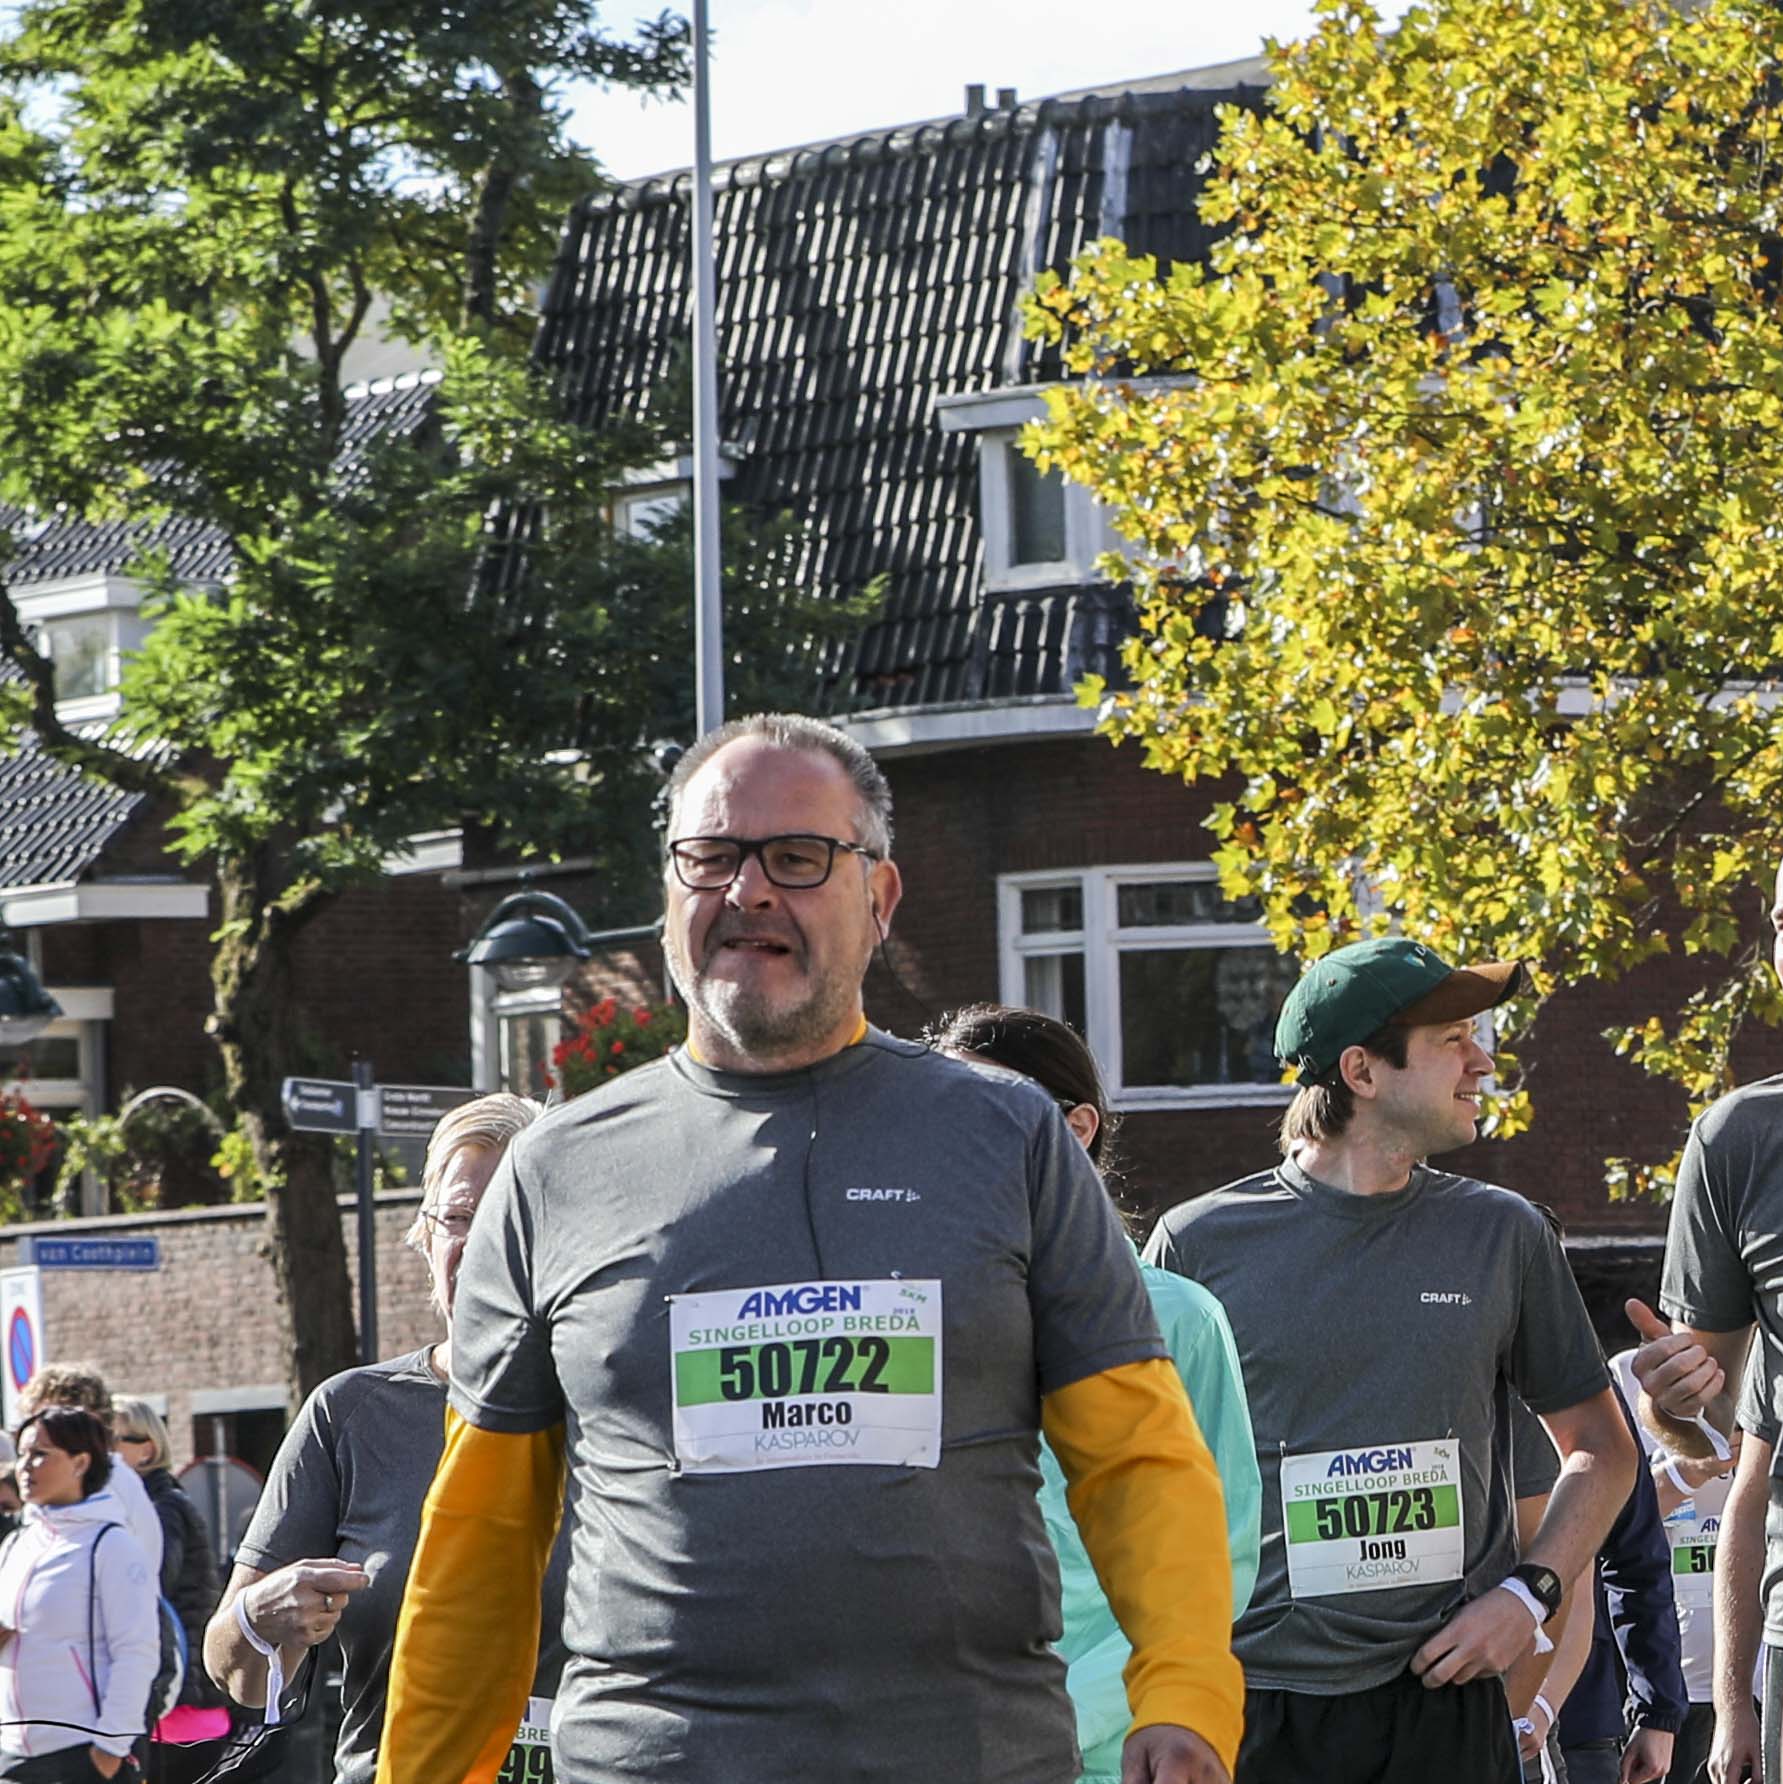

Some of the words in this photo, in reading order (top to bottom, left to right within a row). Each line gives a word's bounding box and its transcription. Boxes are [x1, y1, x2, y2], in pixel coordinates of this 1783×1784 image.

[846, 1187, 904, 1201] CRAFT
[737, 1285, 862, 1320] AMGEN
[1420, 1292, 1461, 1304] CRAFT
[688, 1317, 835, 1346] SINGELLOOP
[843, 1313, 920, 1332] BREDA
[720, 1336, 890, 1402] 50722
[762, 1401, 852, 1430] Marco
[754, 1429, 860, 1452] KASPAROV
[1327, 1447, 1413, 1478] AMGEN
[1294, 1474, 1398, 1497] SINGELLOOP
[1403, 1469, 1448, 1486] BREDA
[1316, 1487, 1437, 1541] 50723
[1360, 1538, 1407, 1561] Jong
[1346, 1558, 1420, 1580] KASPAROV
